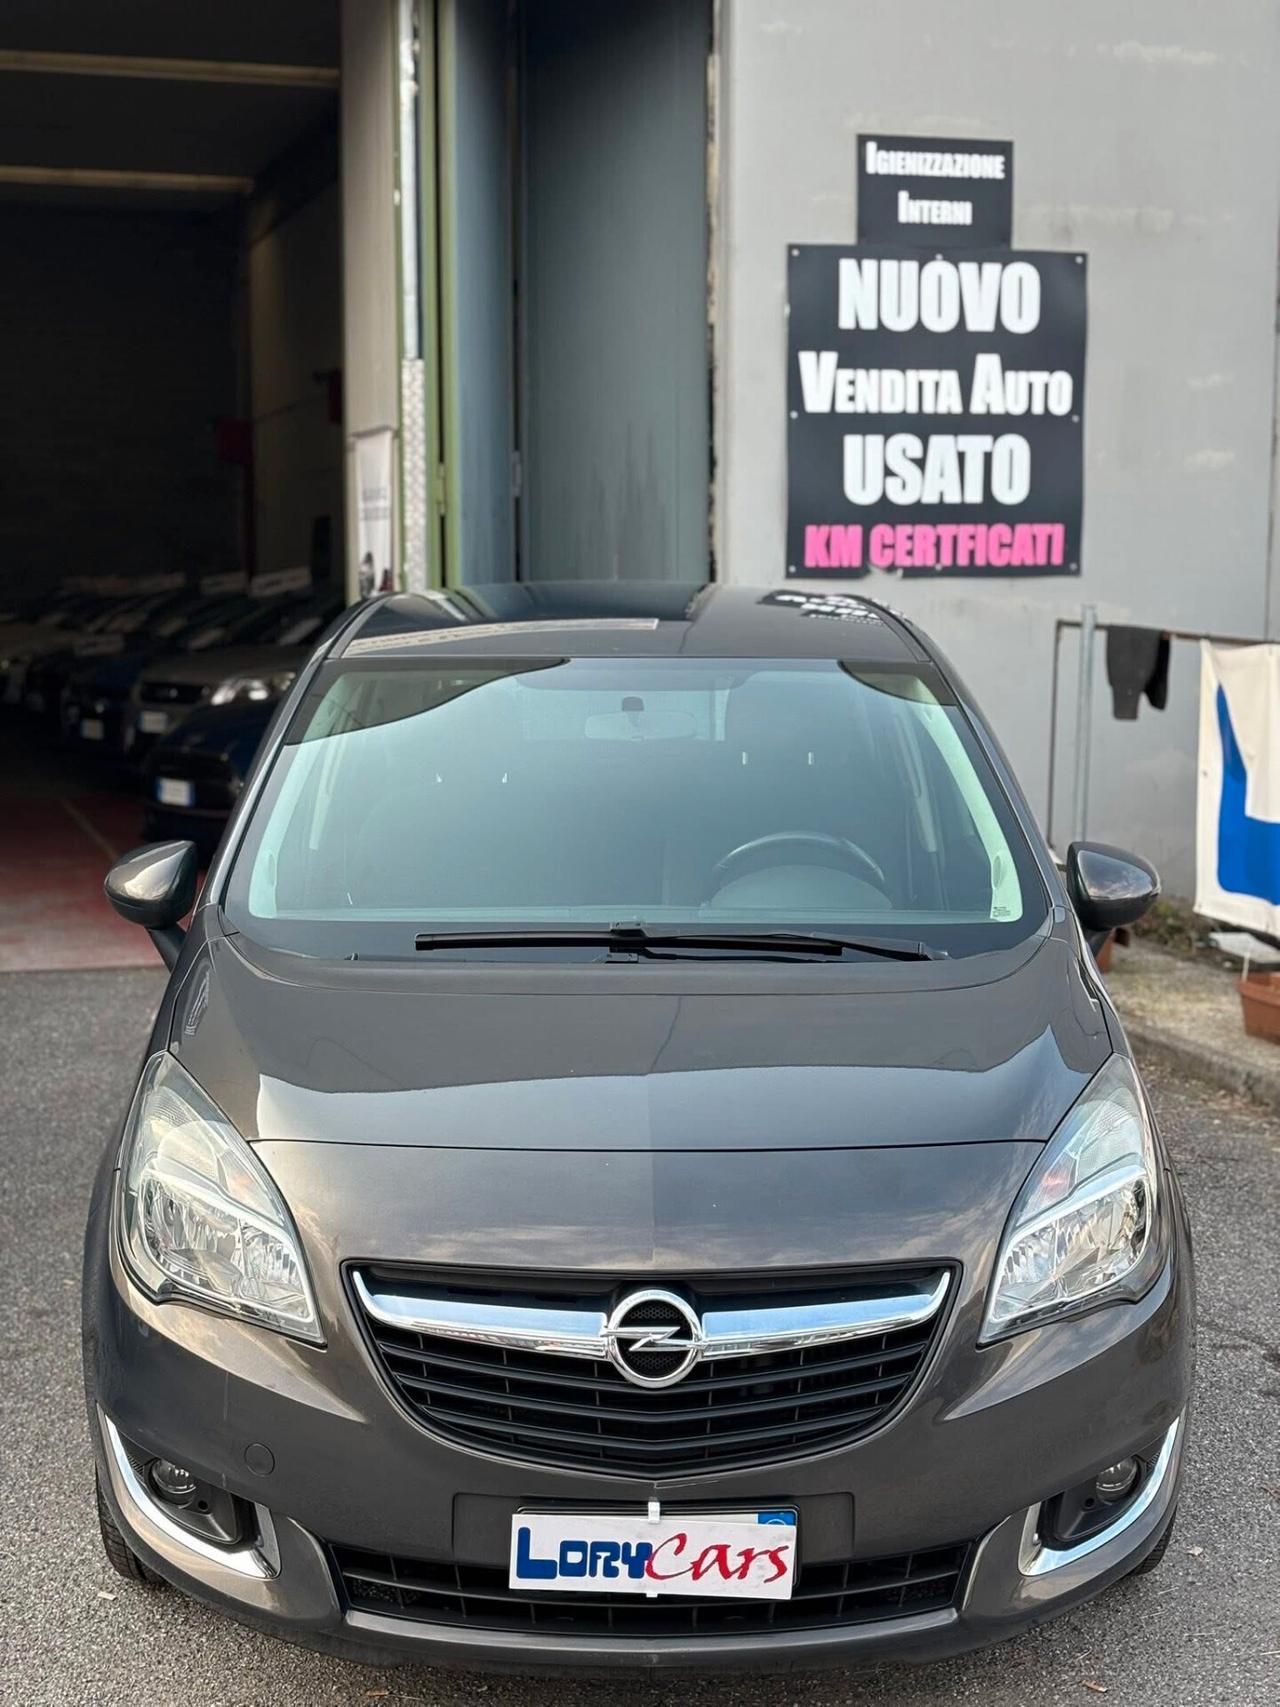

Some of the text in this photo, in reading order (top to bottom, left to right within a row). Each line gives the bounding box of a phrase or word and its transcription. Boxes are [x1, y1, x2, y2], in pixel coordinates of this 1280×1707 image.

[865, 140, 1005, 179] IGIENIZZAZIONE
[897, 190, 973, 226] INTERNI
[838, 258, 1041, 334] NUOVO
[798, 351, 1073, 416] VENDITA AUTO
[843, 432, 1031, 506] USATO
[804, 523, 1065, 568] KM CERTFICATI
